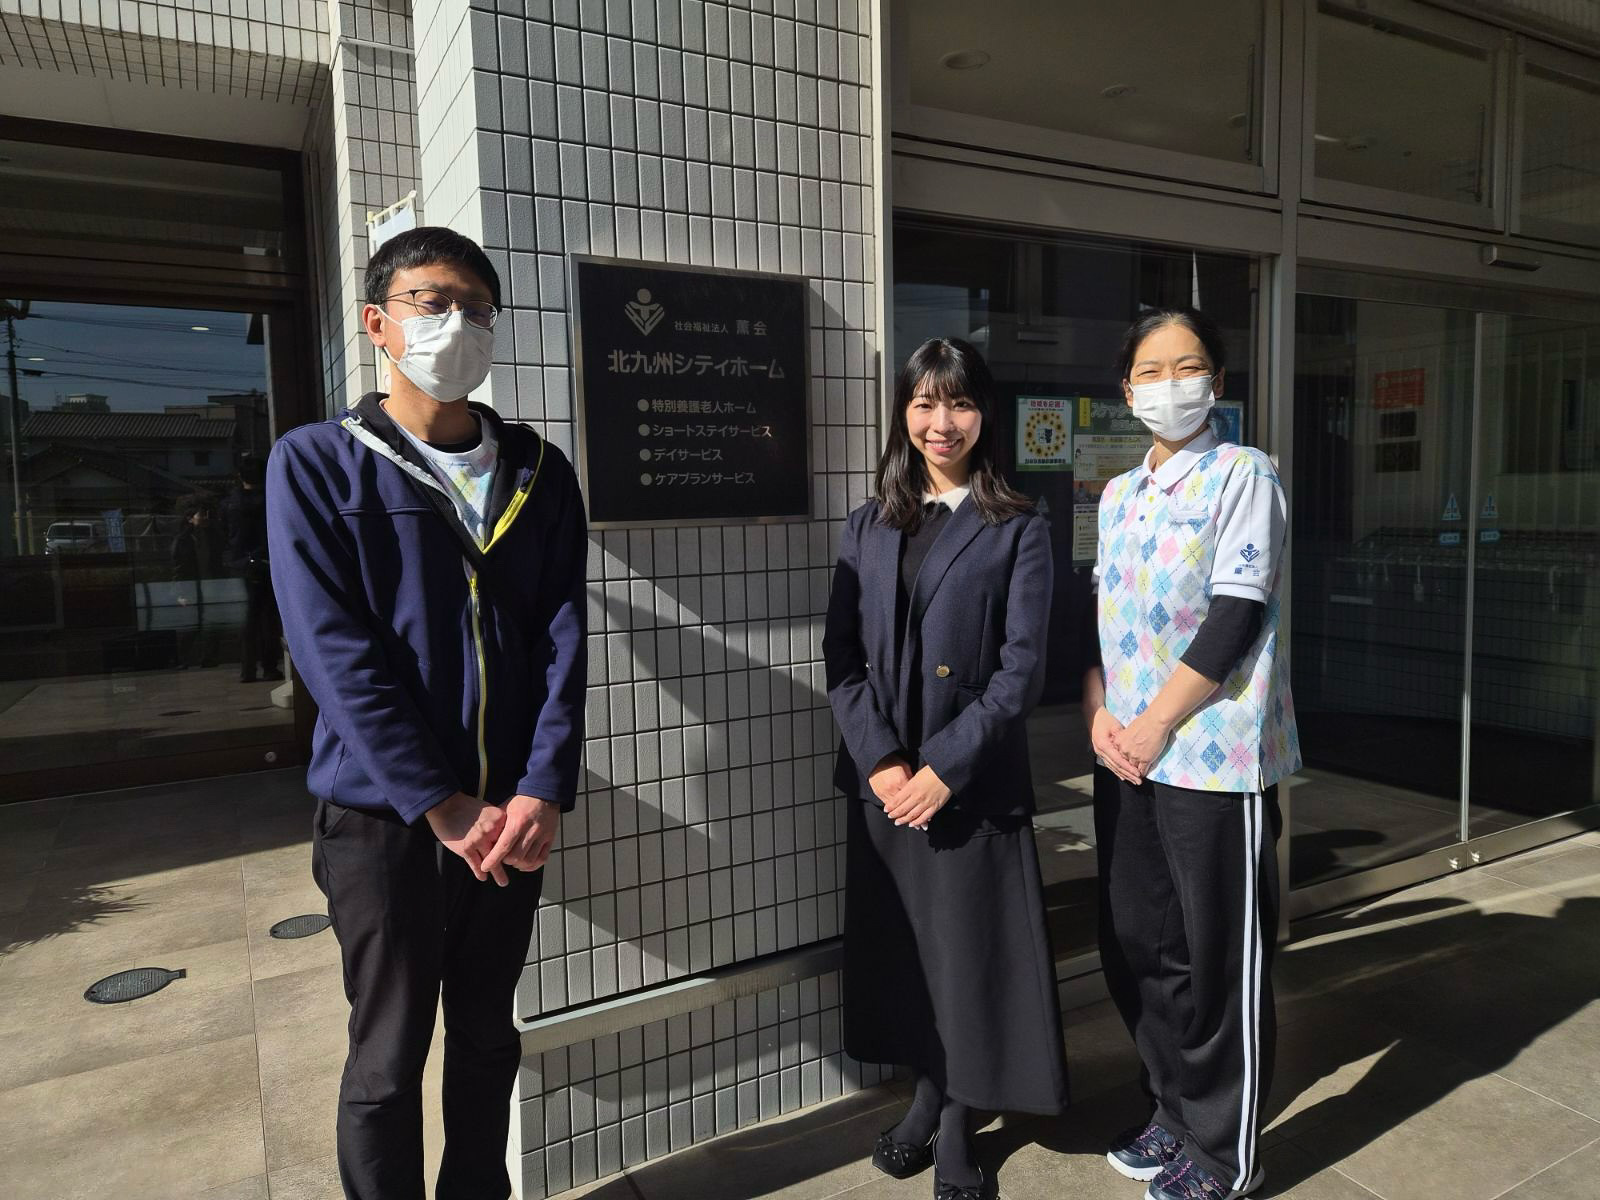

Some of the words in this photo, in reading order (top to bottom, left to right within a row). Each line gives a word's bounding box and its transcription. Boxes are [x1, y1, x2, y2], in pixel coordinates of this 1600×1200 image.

[674, 321, 728, 334] 社会福祉法人
[607, 349, 785, 379] 北九州シティホーム
[652, 399, 756, 414] 特別養護老人ホーム
[653, 424, 773, 438] ショートステイサービス
[654, 448, 724, 462] デイサービス
[655, 472, 756, 486] ケアプランサービス
